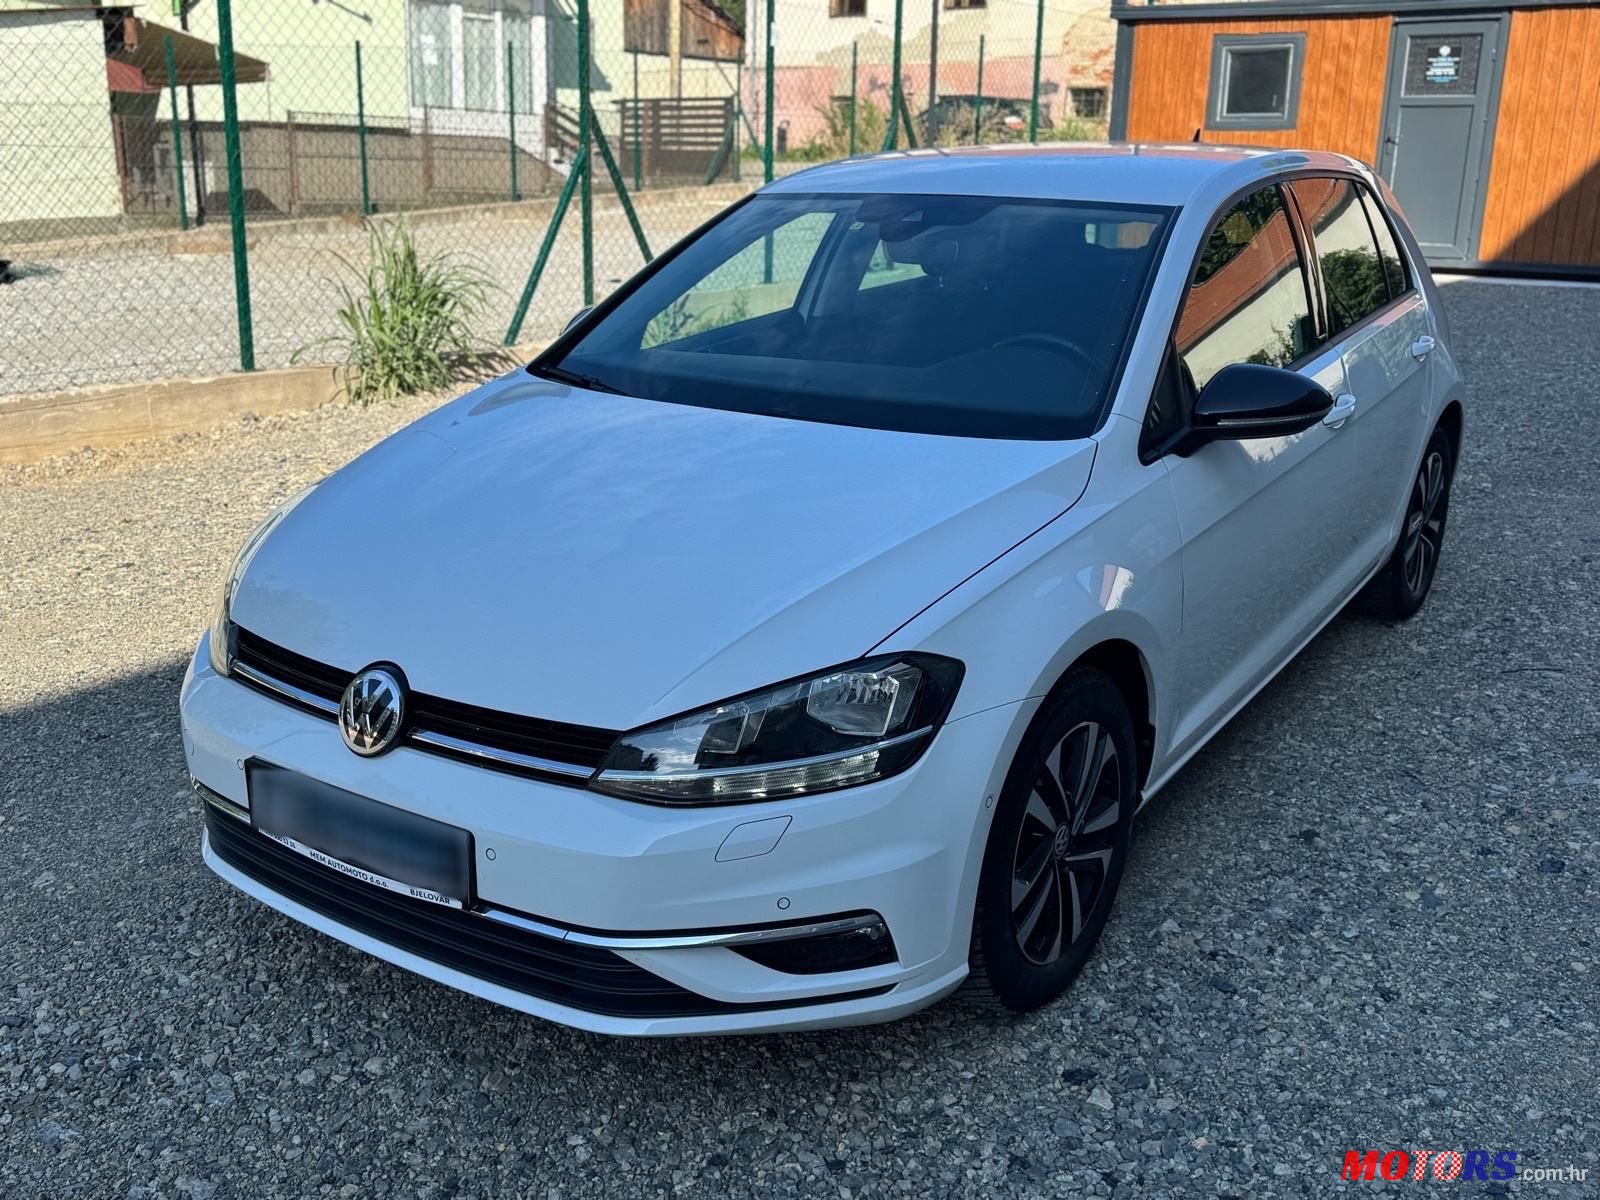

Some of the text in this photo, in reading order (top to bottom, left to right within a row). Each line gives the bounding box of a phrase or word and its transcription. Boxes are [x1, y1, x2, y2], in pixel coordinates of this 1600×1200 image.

[310, 850, 389, 888] MEM AUTOMOTO d.o.o.
[409, 888, 451, 905] BJELOVAR
